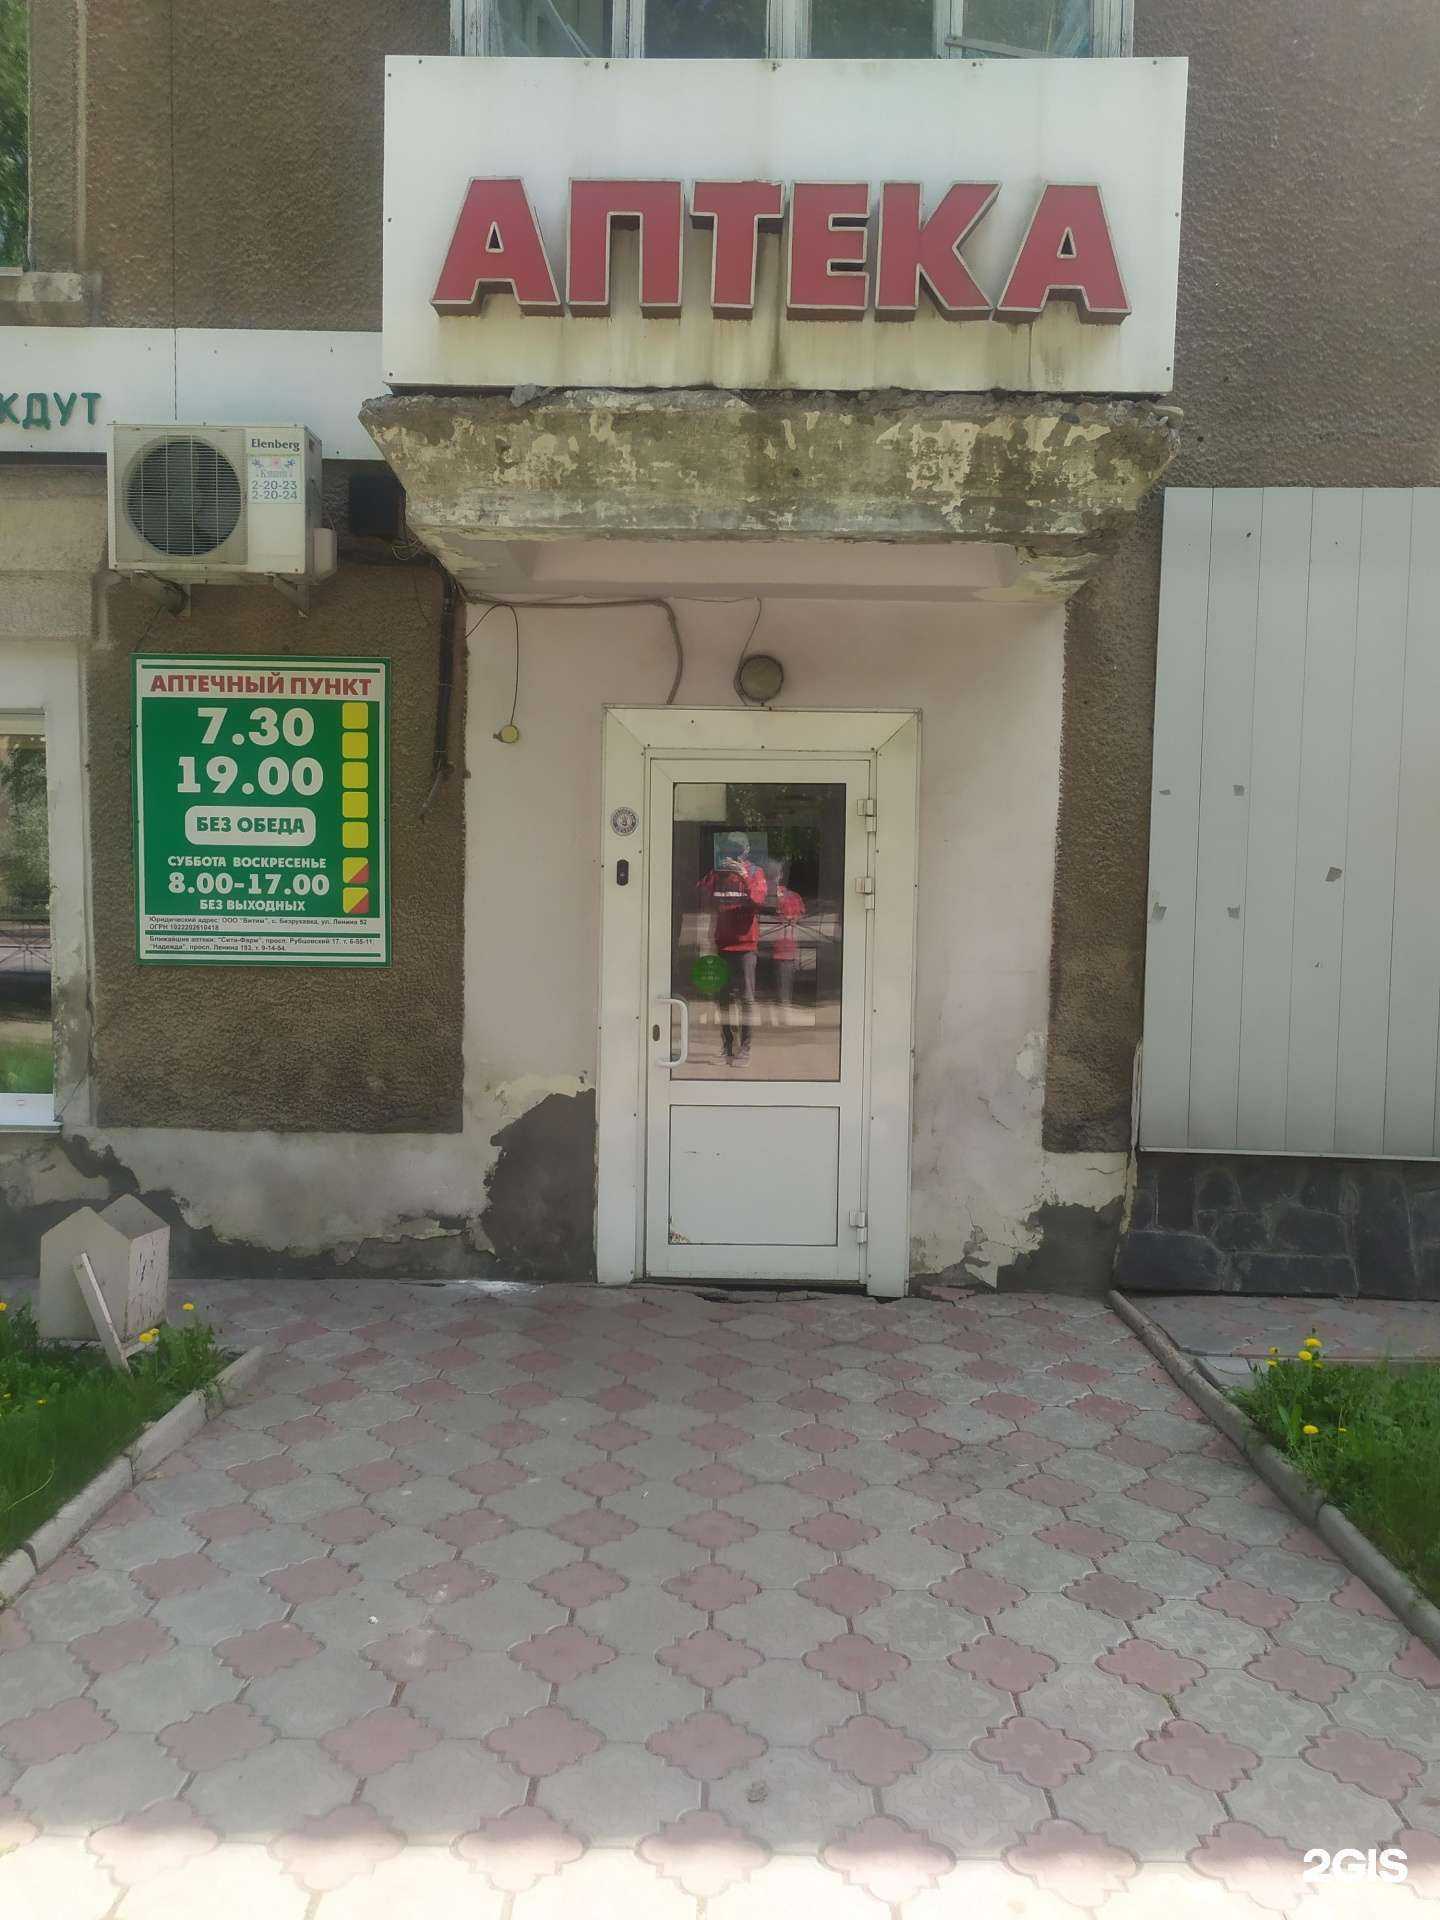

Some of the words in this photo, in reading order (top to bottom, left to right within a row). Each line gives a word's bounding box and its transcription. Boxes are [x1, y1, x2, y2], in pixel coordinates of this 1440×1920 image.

[431, 176, 1131, 321] АПТЕКА
[251, 438, 300, 452] Elenberg
[251, 480, 298, 490] 2-20-23
[251, 490, 298, 500] 2-20-24
[150, 671, 284, 694] АПТЕЧНЫЙ
[290, 677, 371, 696] ПУНКТ
[197, 707, 315, 747] 7.30
[177, 756, 324, 796] 19.00
[196, 816, 232, 832] БЕЗ
[237, 817, 305, 836] ОБЕДА
[167, 856, 227, 867] СУББОТА
[233, 857, 327, 869] ВОСКРЕСЕНЬЕ
[168, 872, 330, 896] 8.00-17.00
[200, 899, 223, 911] БЕЗ
[226, 900, 306, 912] ВЫХОДНЫХ
